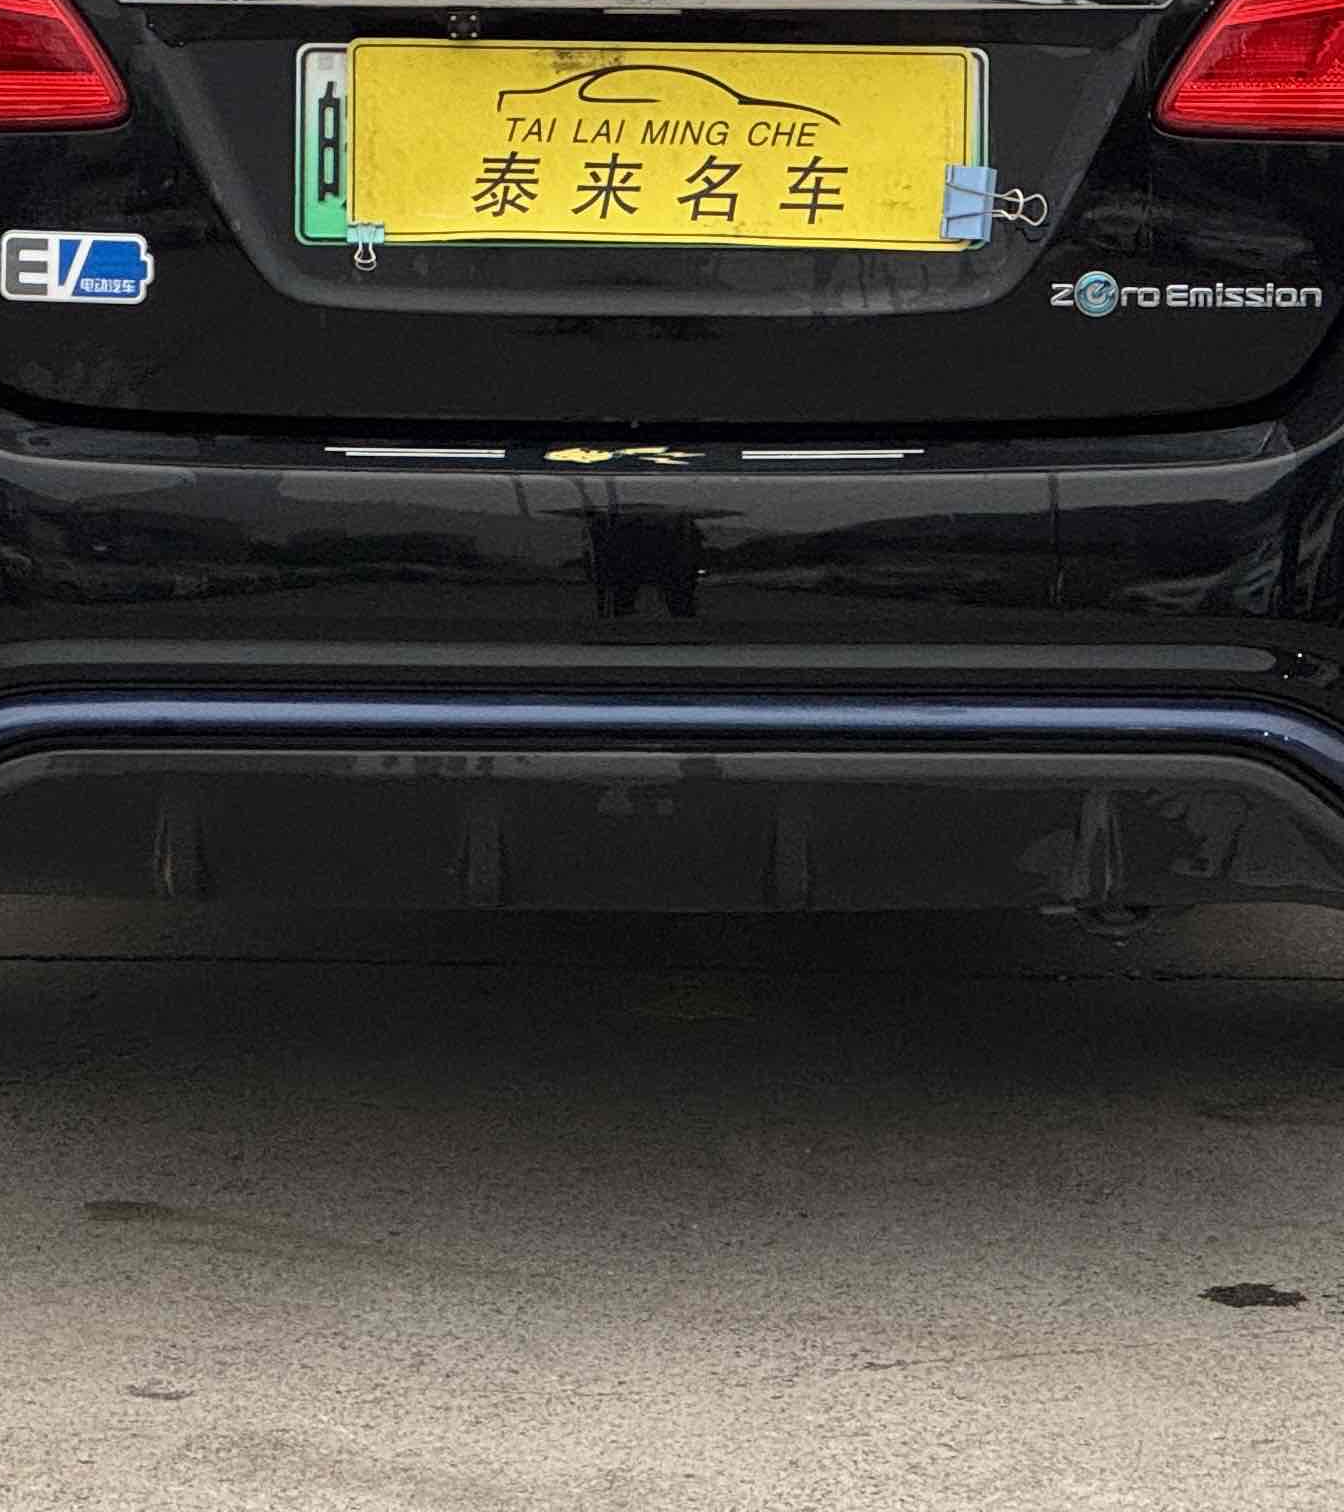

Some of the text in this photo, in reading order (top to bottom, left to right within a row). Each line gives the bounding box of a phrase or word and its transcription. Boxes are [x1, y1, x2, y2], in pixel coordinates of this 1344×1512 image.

[505, 117, 820, 148] TAI LAI MING CHE
[471, 150, 850, 225] 泰来名车
[2, 232, 94, 298] EV
[1166, 282, 1323, 308] Emission
